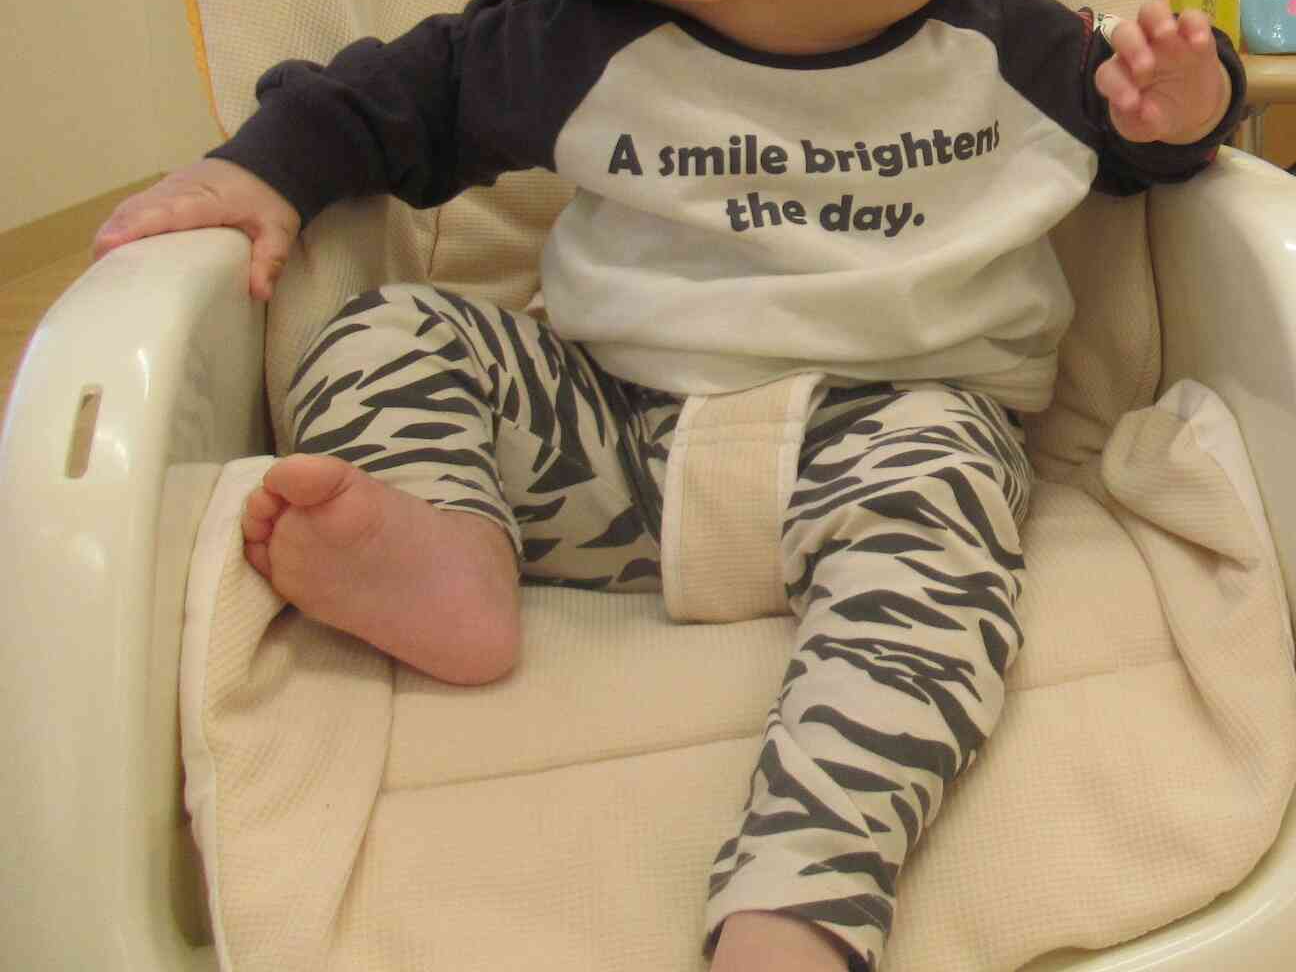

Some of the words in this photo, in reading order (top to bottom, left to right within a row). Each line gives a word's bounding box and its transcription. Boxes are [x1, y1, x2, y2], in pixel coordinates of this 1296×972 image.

[608, 133, 643, 176] A
[658, 134, 789, 176] smile
[800, 119, 1000, 177] brightens
[725, 192, 808, 233] the
[819, 194, 926, 237] day.
